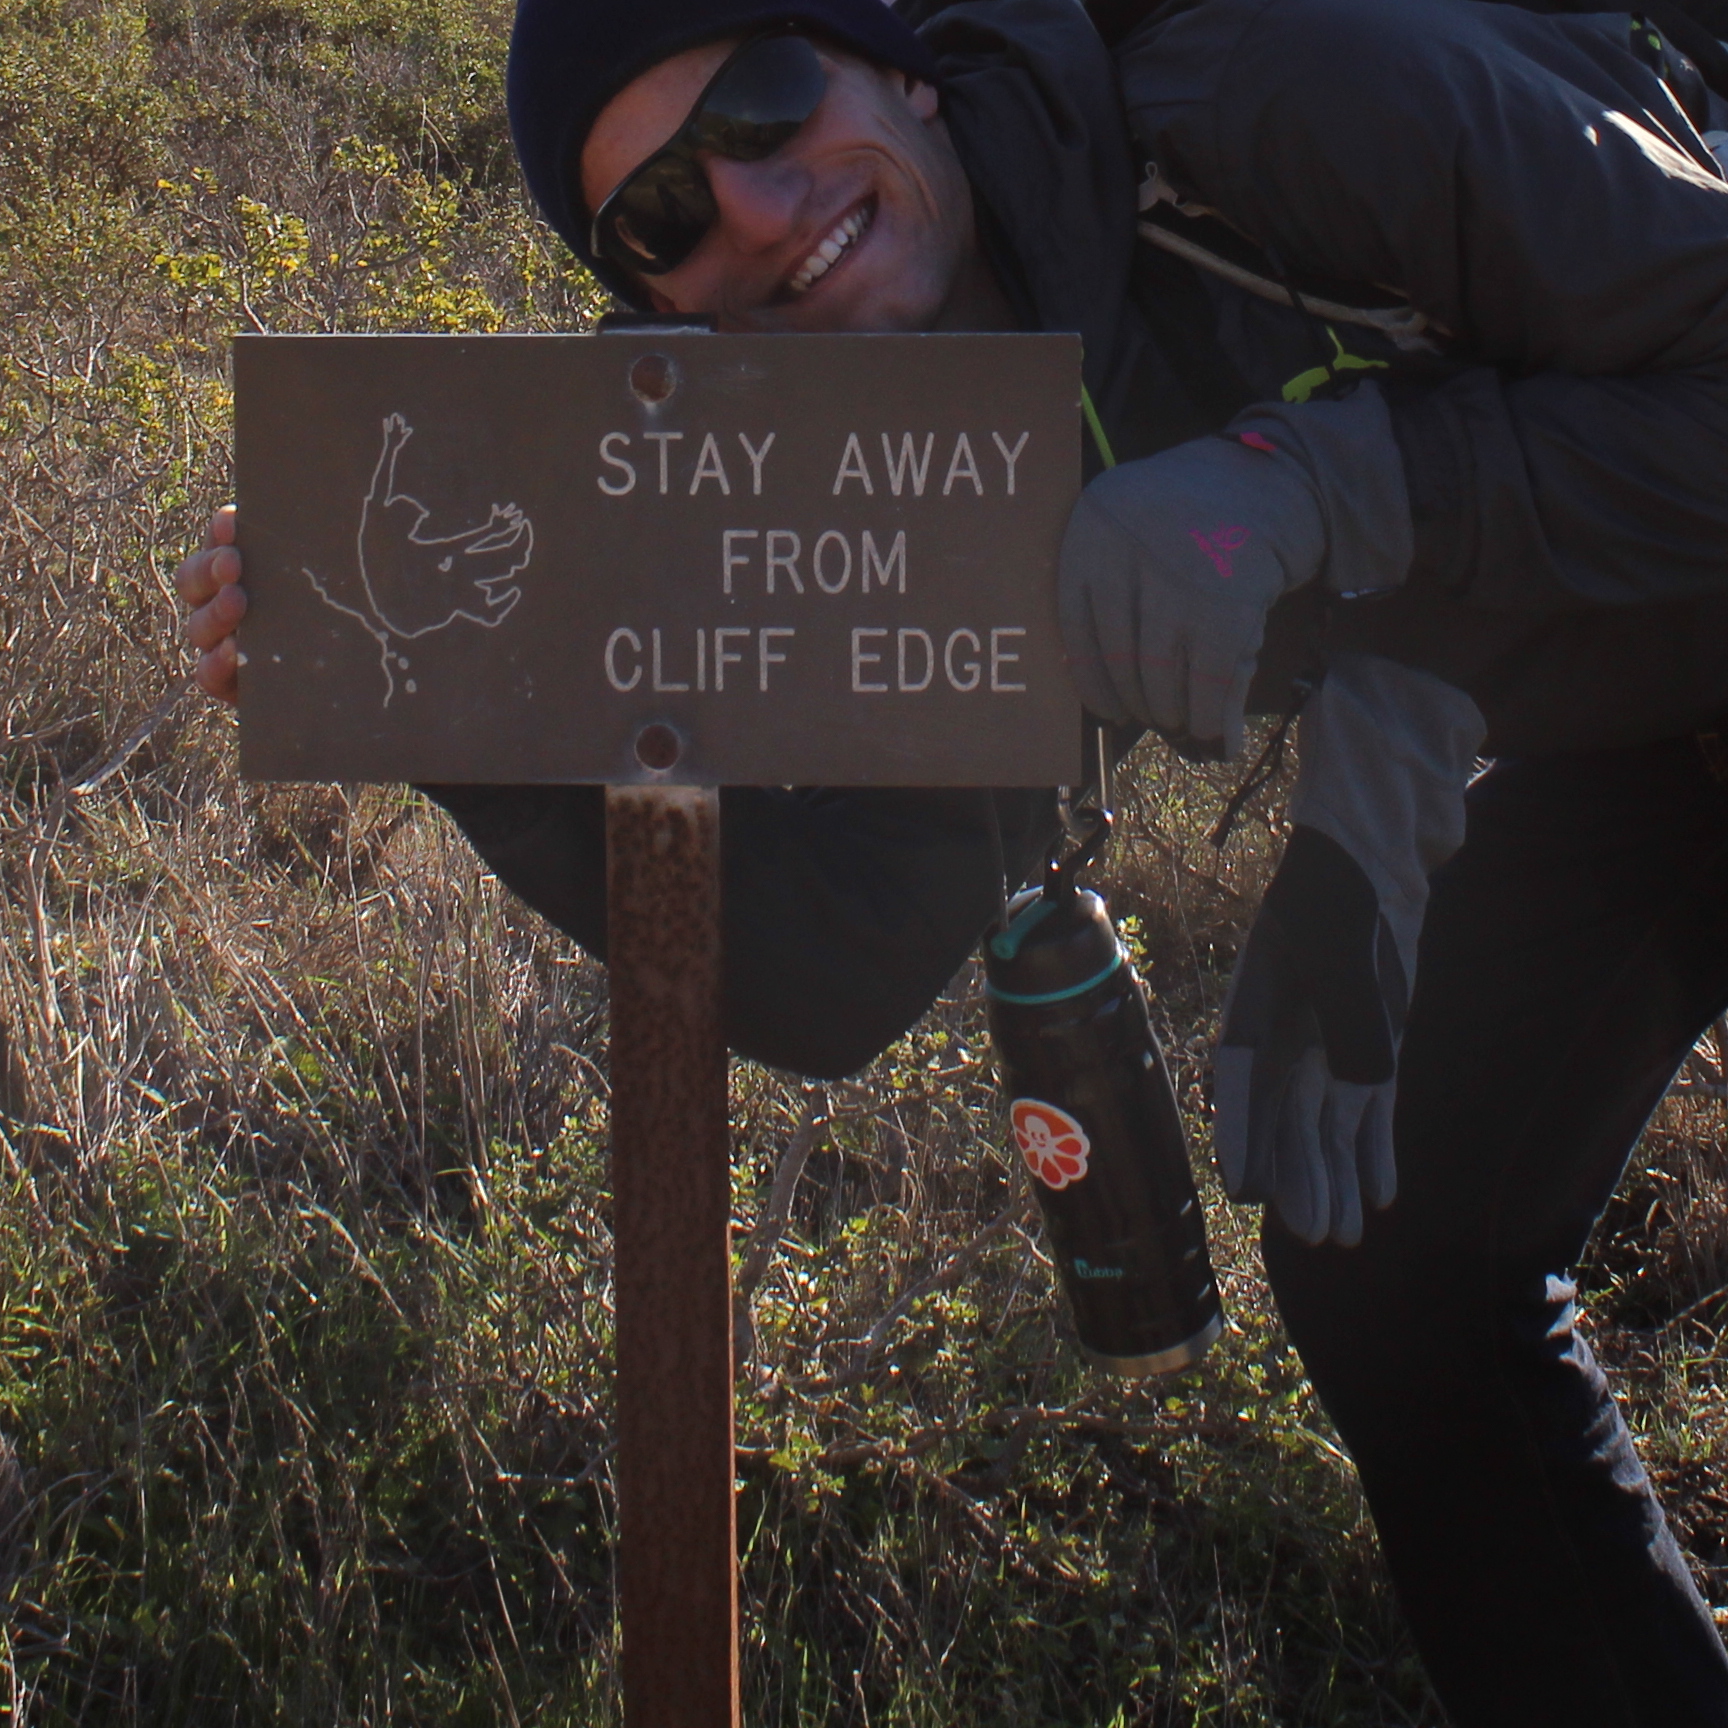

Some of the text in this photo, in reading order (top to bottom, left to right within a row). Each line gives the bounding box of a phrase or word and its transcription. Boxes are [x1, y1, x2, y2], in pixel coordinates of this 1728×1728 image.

[596, 431, 1030, 497] STAY AWAY
[722, 529, 907, 595] FROM
[604, 627, 1027, 693] CLIFF EDGE
